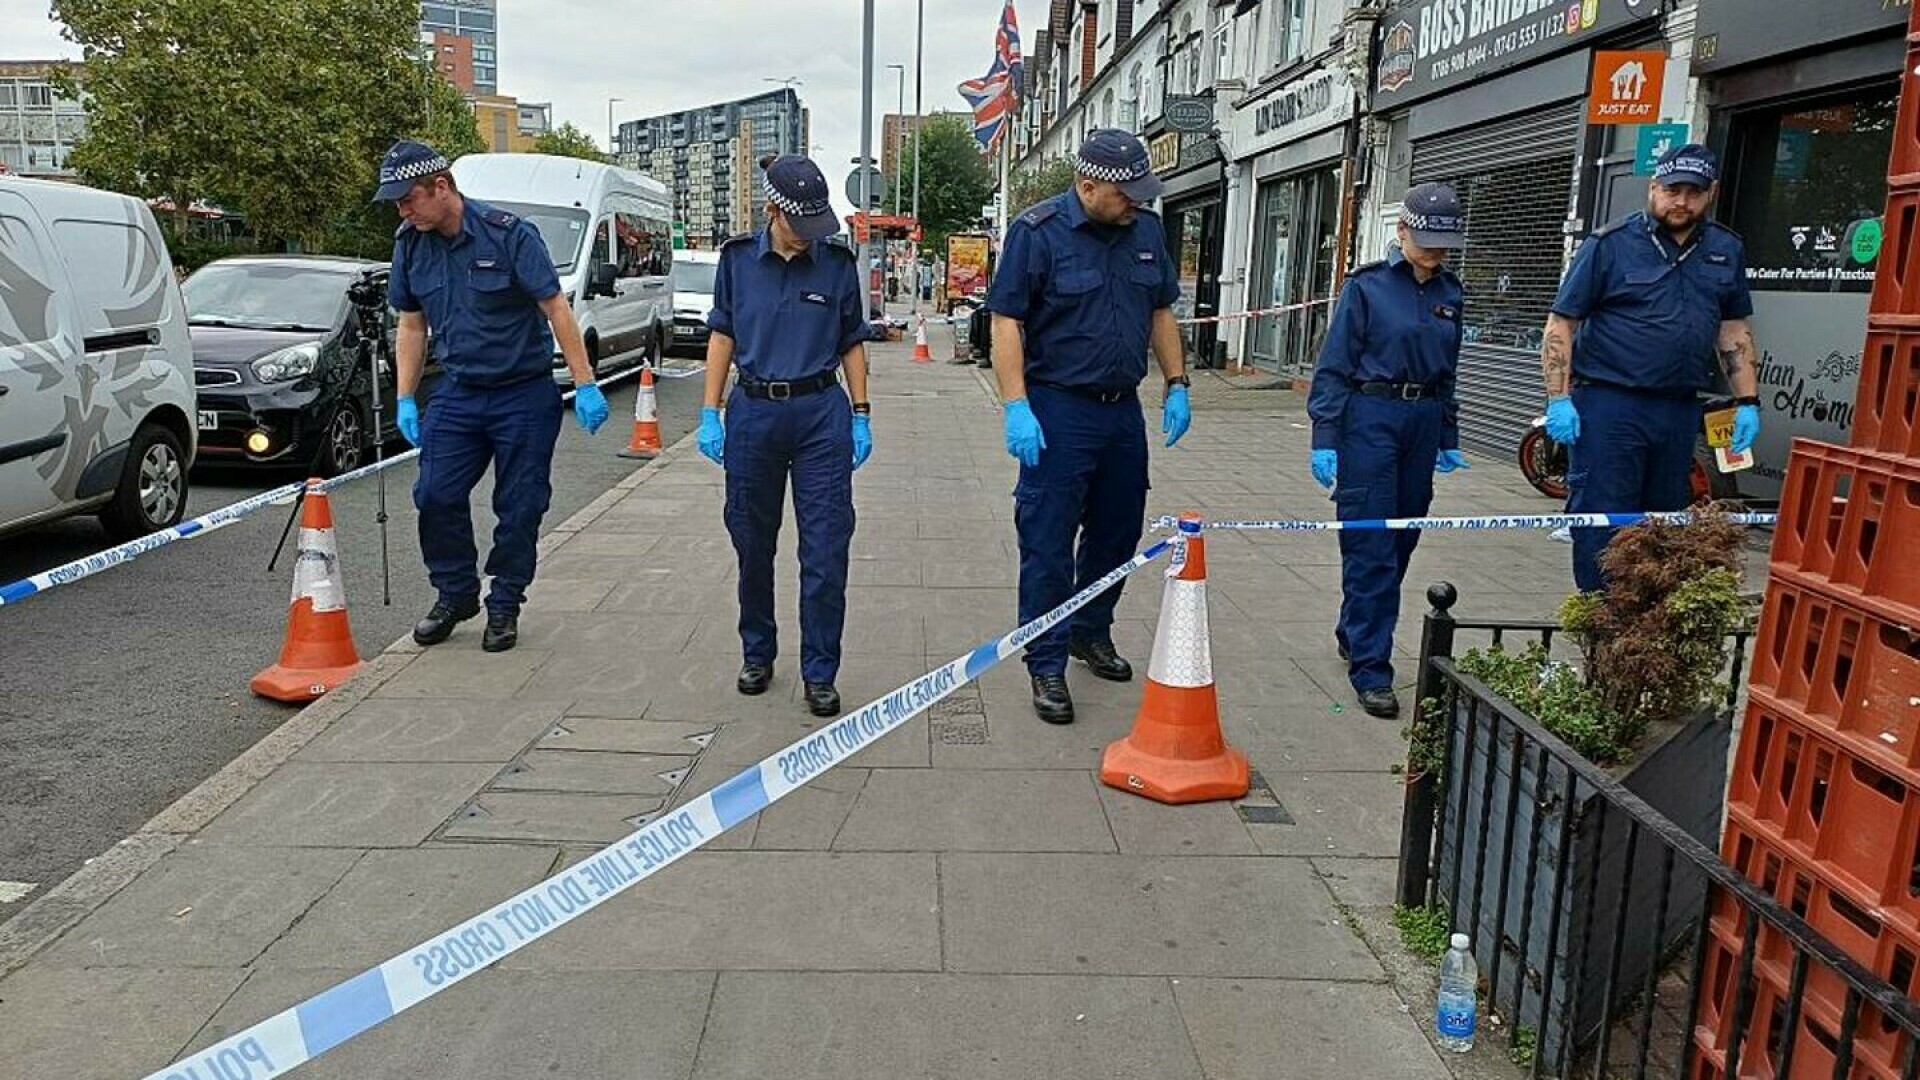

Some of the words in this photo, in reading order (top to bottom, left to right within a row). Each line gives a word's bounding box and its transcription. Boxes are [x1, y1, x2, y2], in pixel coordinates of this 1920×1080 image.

[1418, 0, 1466, 59] BOSS
[1469, 0, 1554, 39] BARB
[1518, 25, 1537, 49] 555
[1598, 103, 1625, 115] JUST
[1627, 103, 1652, 115] EAT
[1744, 267, 1757, 279] We
